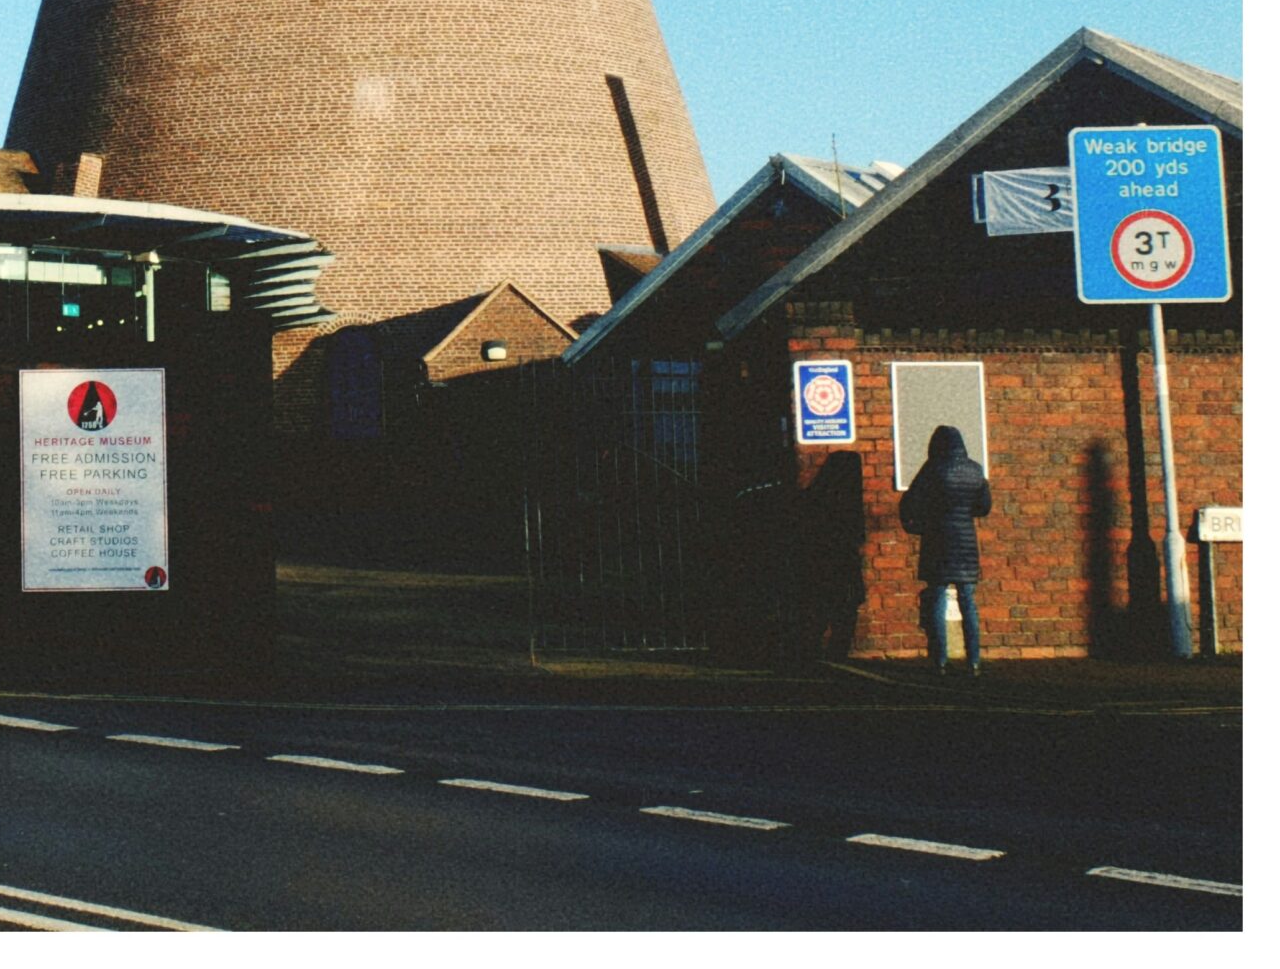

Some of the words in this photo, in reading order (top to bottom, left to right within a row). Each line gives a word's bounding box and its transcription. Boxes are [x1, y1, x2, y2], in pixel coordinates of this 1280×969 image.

[1083, 138, 1138, 155] Weak
[1146, 137, 1208, 156] bridge
[1105, 159, 1146, 176] 200
[1155, 159, 1189, 178] yds
[1119, 180, 1179, 198] ahead
[34, 437, 95, 447] HERITAGE
[99, 436, 152, 446] MUSEUM
[31, 453, 69, 464] FREE
[74, 452, 156, 464] ADMISSION
[40, 469, 78, 480] FREE
[83, 468, 149, 480] PARKING
[66, 488, 92, 496] OPEN
[94, 488, 122, 496] DAILY
[57, 524, 95, 534] RETAIL
[99, 524, 130, 534] SHOP
[49, 536, 85, 547] CRAFT
[89, 536, 139, 546] STUDIOS
[50, 548, 96, 558] COFFEE
[99, 548, 138, 558] HOUSE
